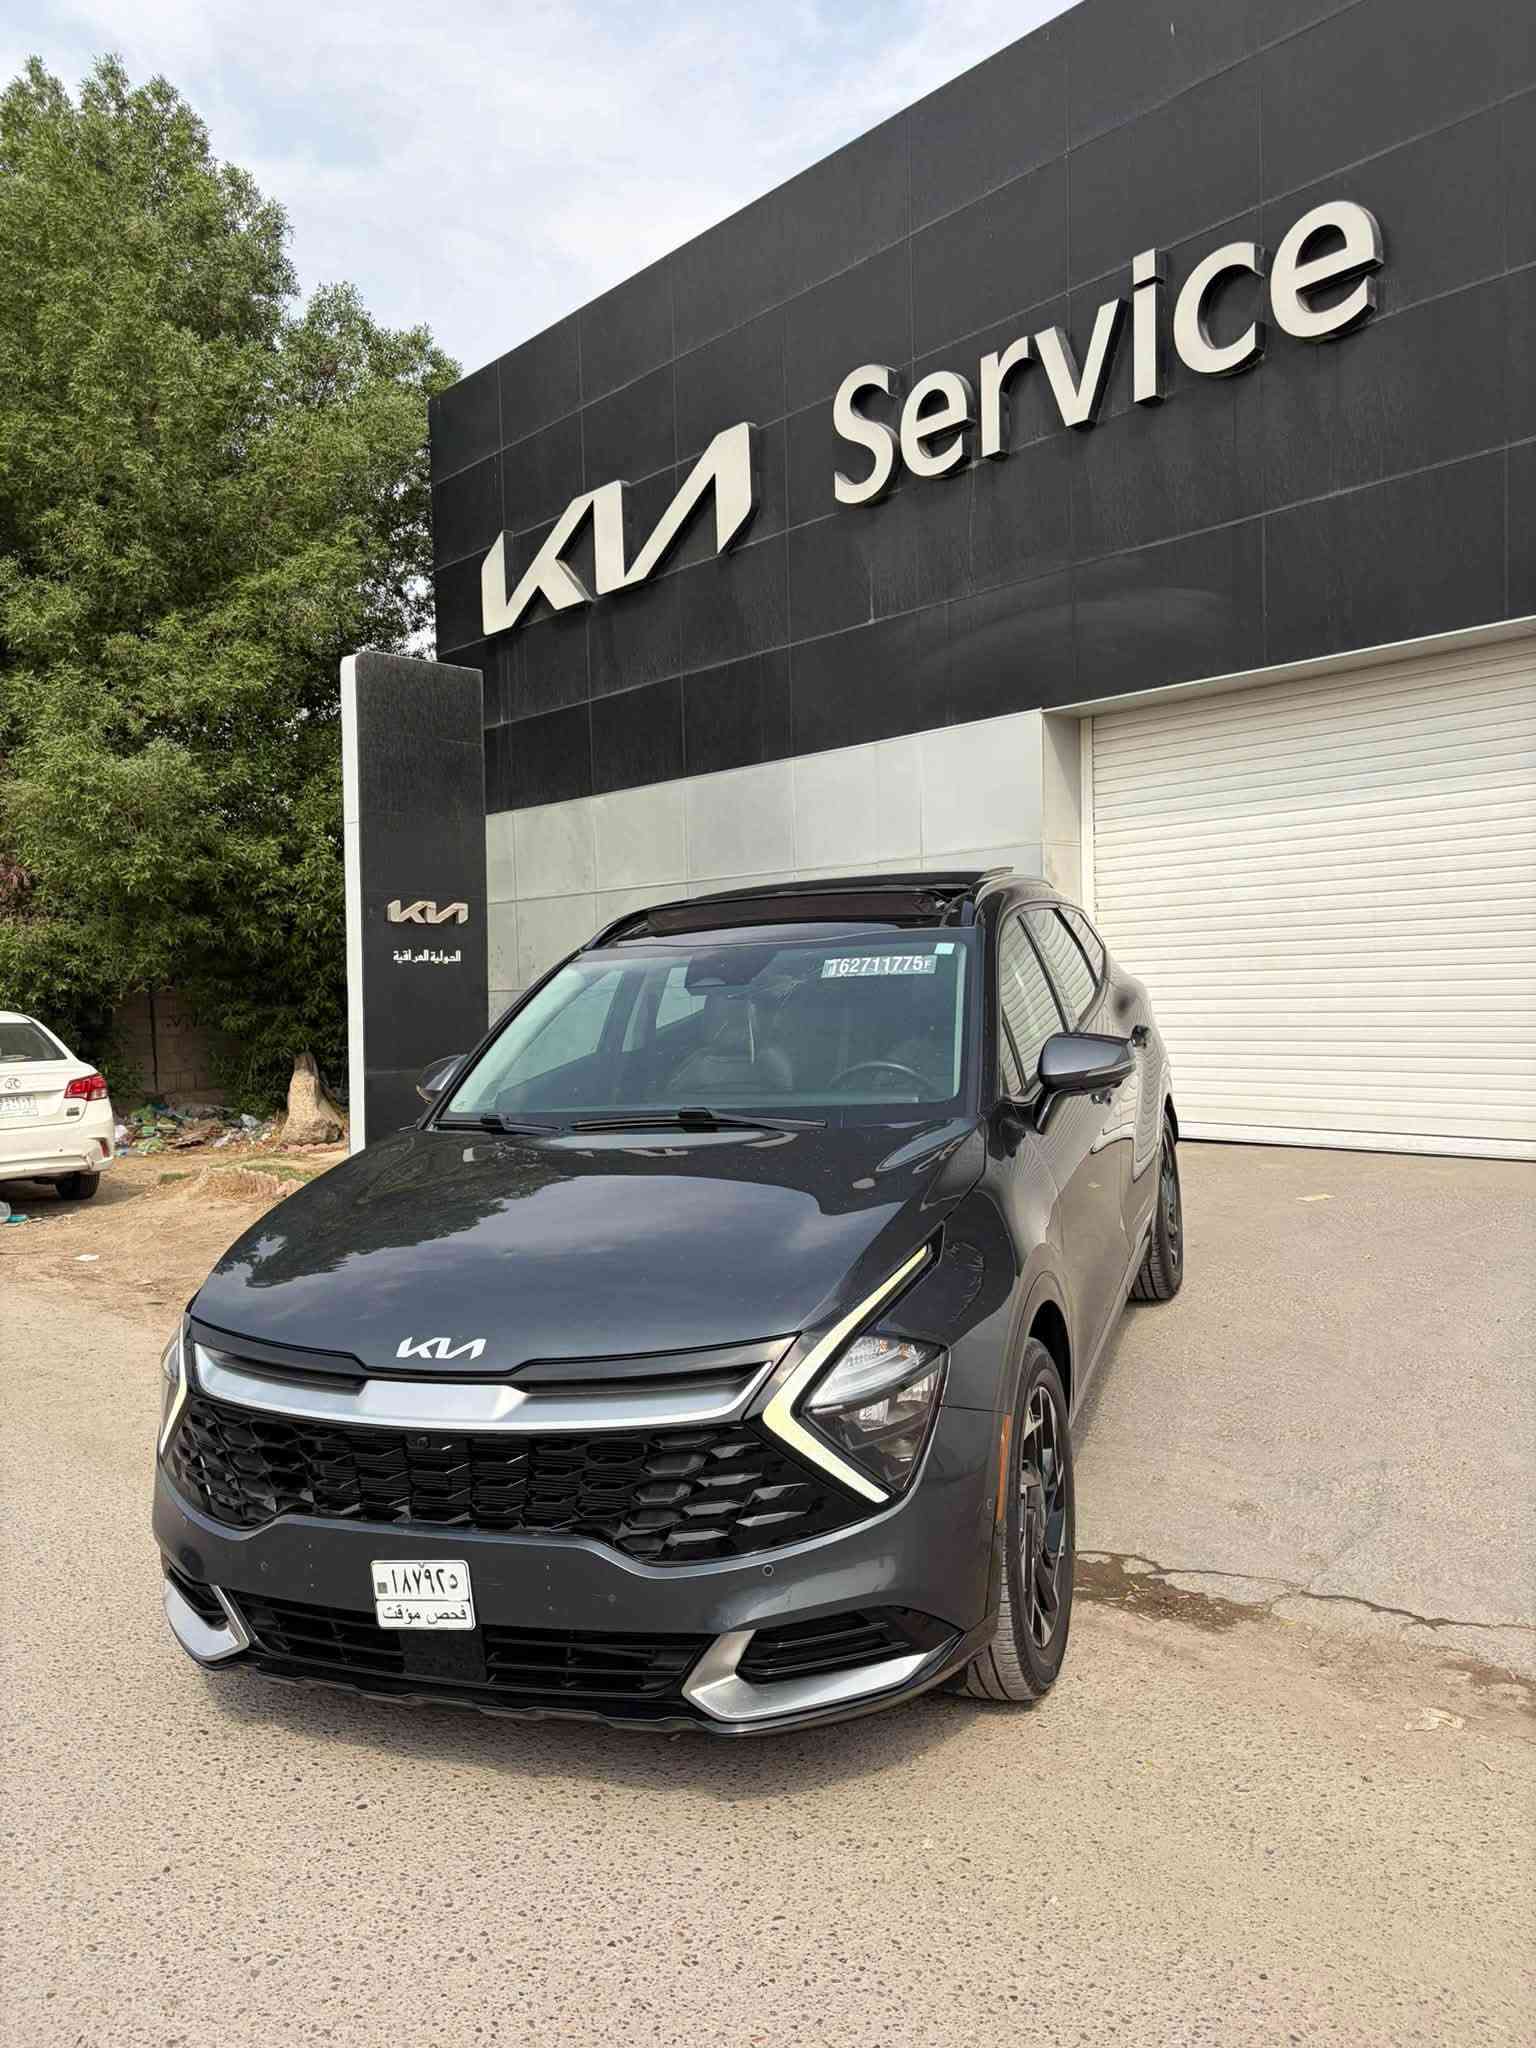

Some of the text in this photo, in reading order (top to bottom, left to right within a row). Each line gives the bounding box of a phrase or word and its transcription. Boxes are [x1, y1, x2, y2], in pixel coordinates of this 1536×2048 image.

[481, 200, 1384, 637] KIA Service
[386, 899, 469, 925] KIA
[395, 1336, 487, 1360] KIA
[383, 1603, 468, 1625] فحص مؤقت
